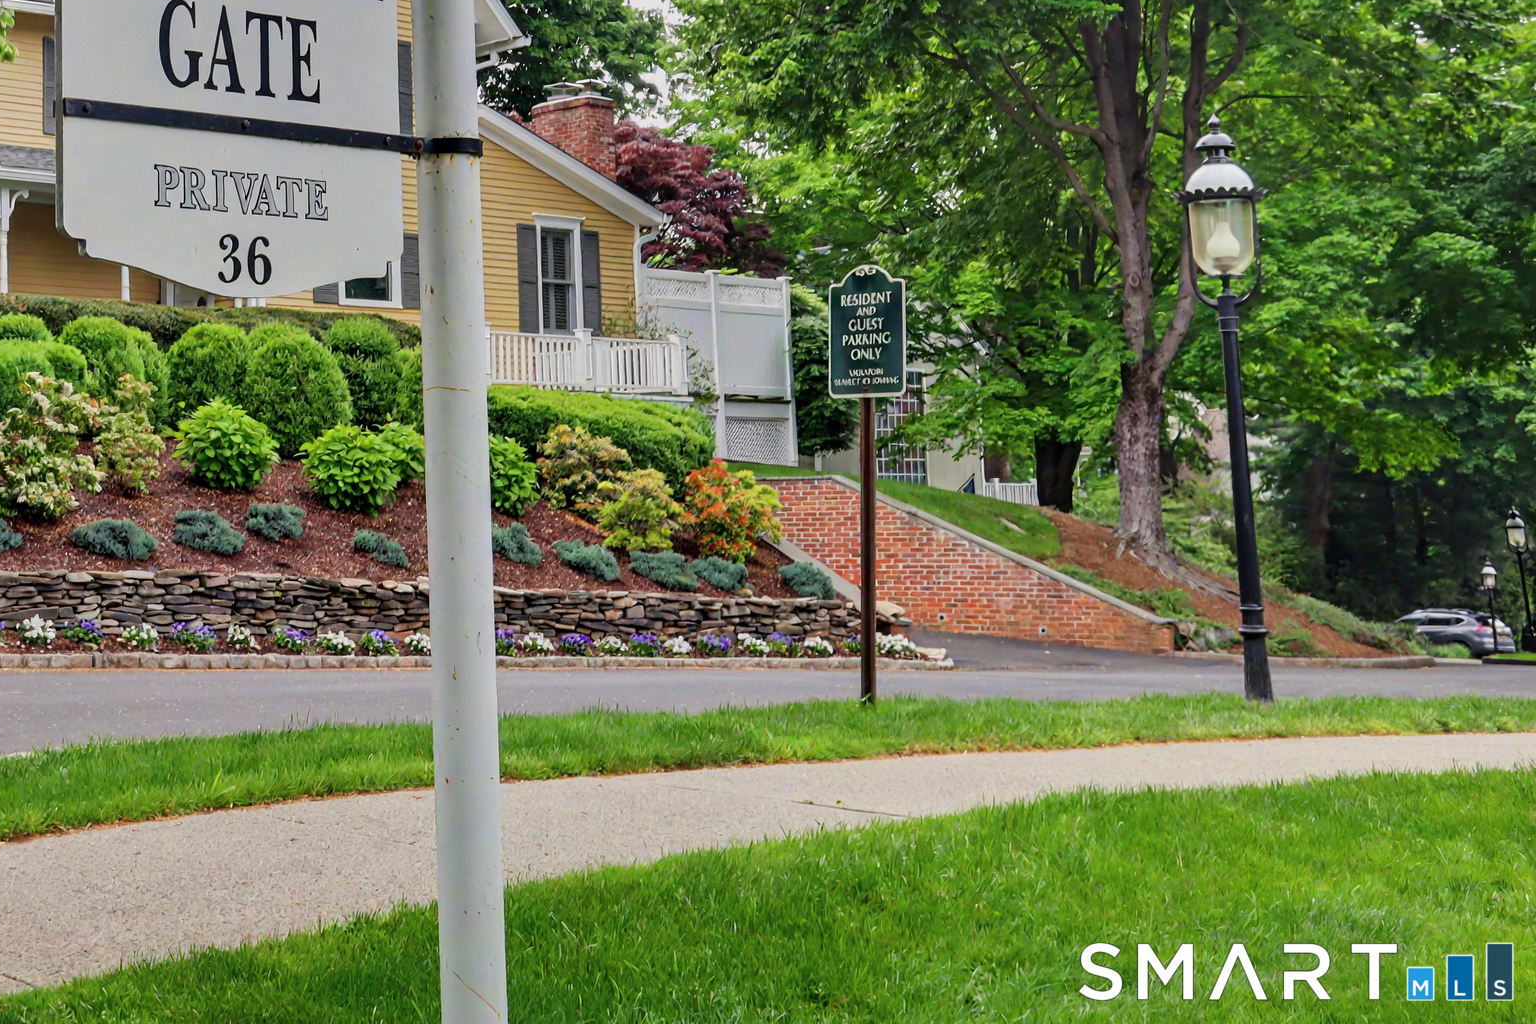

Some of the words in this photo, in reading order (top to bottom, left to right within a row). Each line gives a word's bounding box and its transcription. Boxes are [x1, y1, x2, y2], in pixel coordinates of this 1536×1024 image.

[154, 163, 330, 222] PRIVATE
[218, 233, 273, 285] 36
[840, 291, 892, 306] RESIDENT
[856, 306, 877, 316] AND
[848, 317, 884, 331] GUEST
[842, 332, 891, 347] PARKING
[850, 347, 882, 361] ONLY
